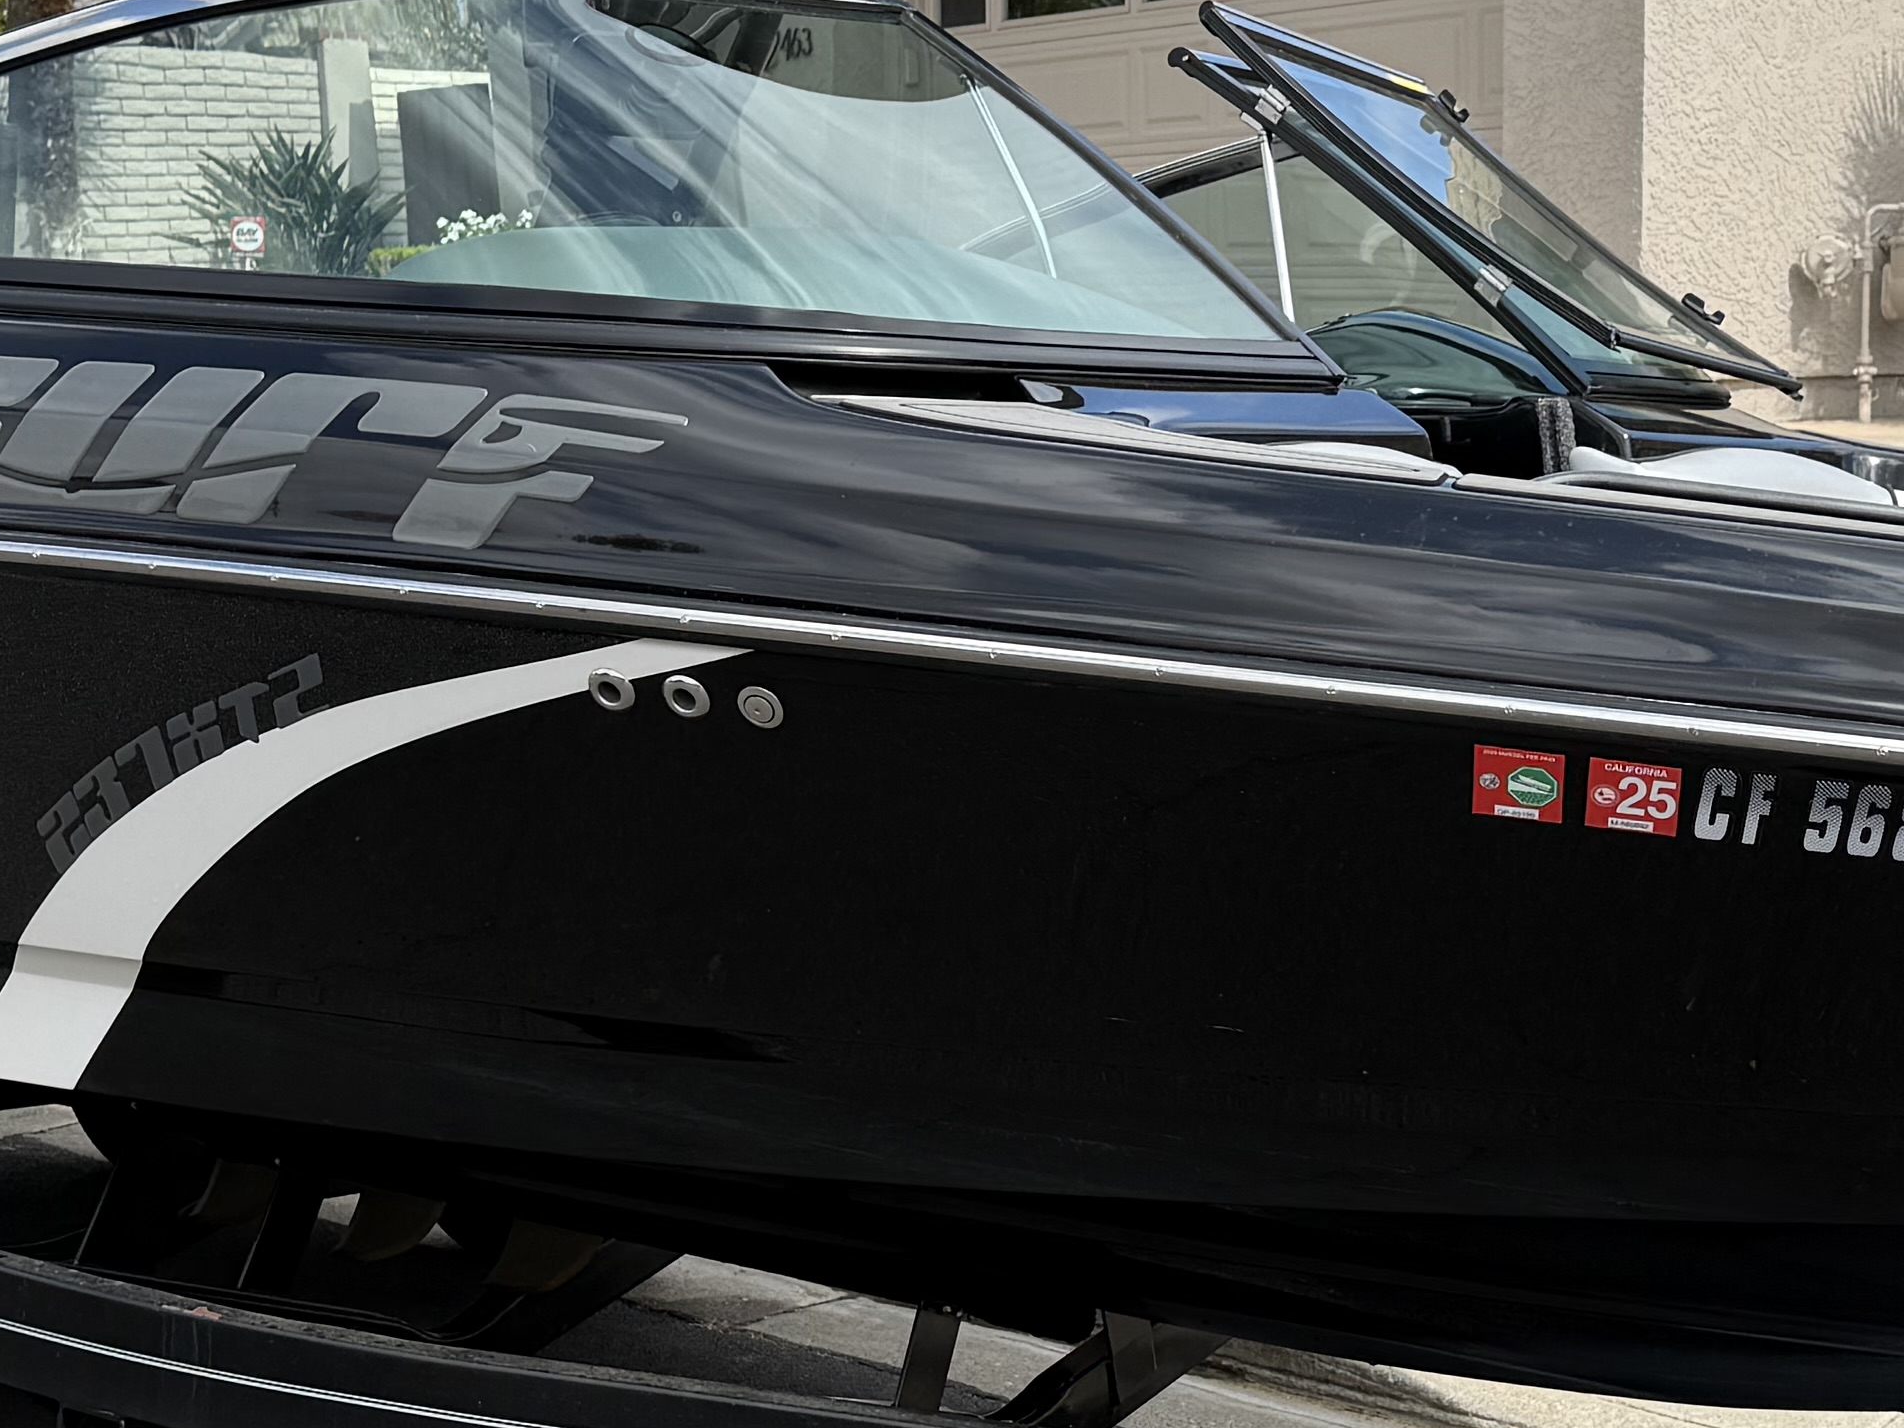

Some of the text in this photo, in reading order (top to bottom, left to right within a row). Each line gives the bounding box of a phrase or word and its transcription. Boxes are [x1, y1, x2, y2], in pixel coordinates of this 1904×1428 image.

[1604, 763, 1668, 778] CALIFORNIA
[1615, 775, 1677, 820] 25
[1693, 767, 1779, 845] CF
